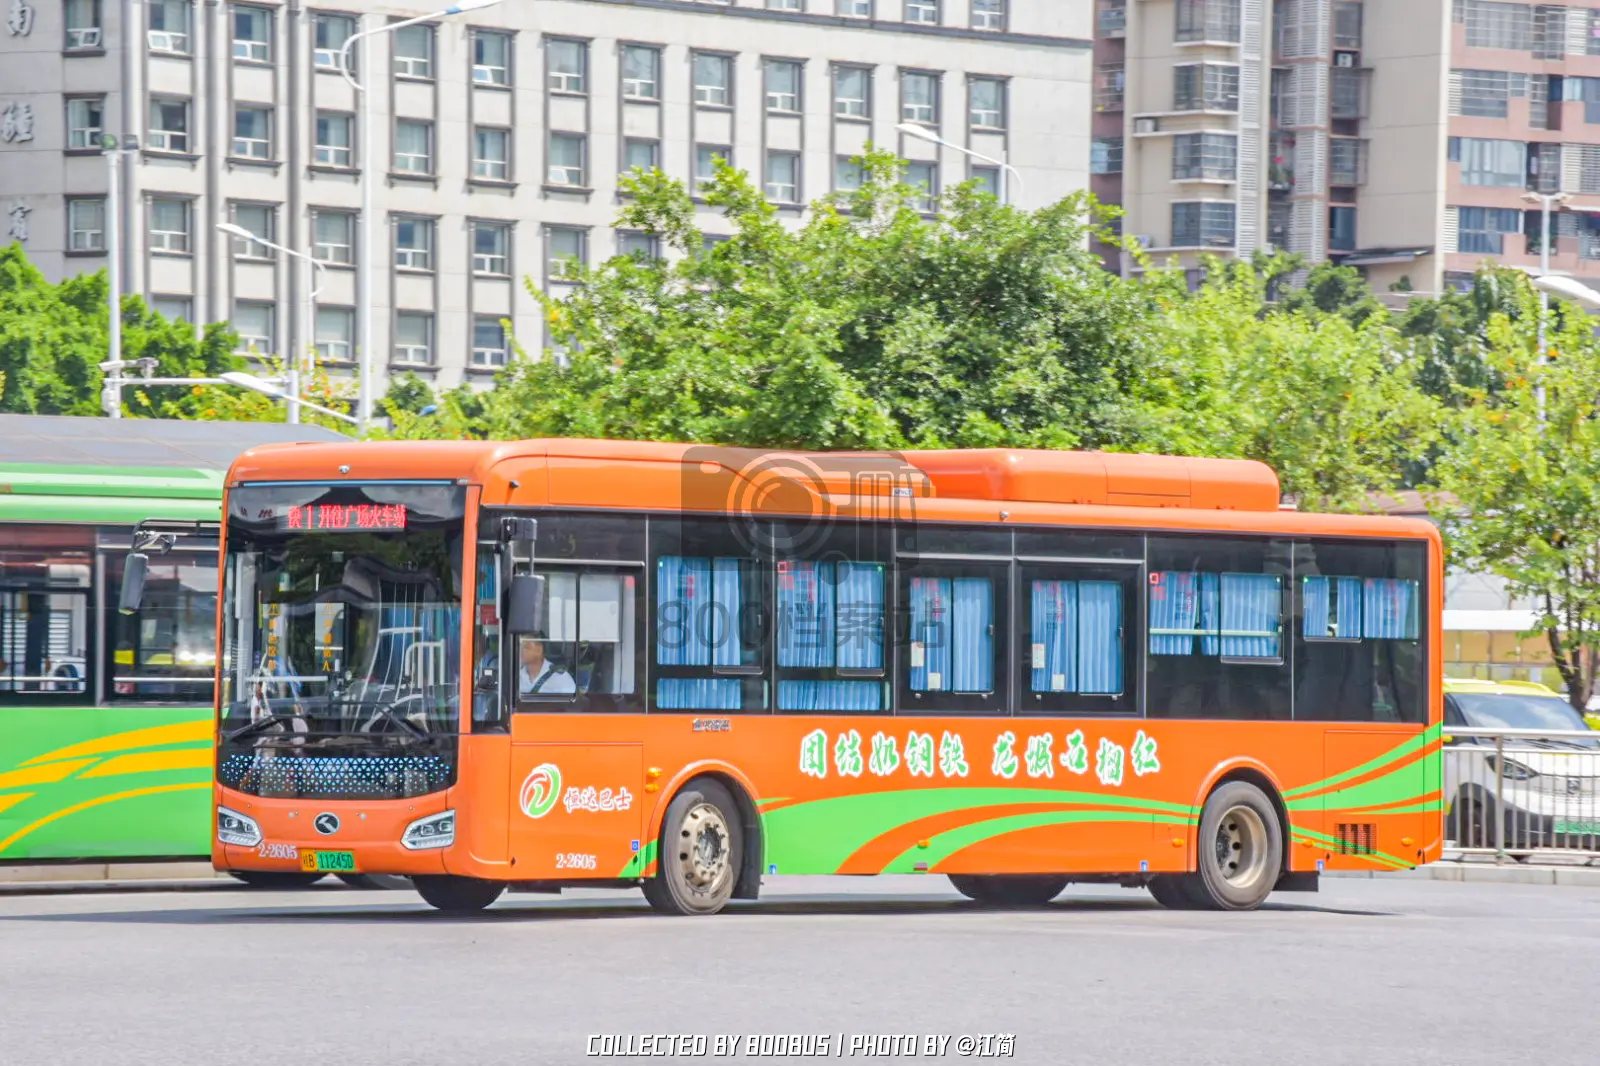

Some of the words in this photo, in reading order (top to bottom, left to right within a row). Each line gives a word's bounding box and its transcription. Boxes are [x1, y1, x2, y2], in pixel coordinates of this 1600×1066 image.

[563, 786, 633, 813] 恒达巴士
[556, 852, 597, 870] 2-2605
